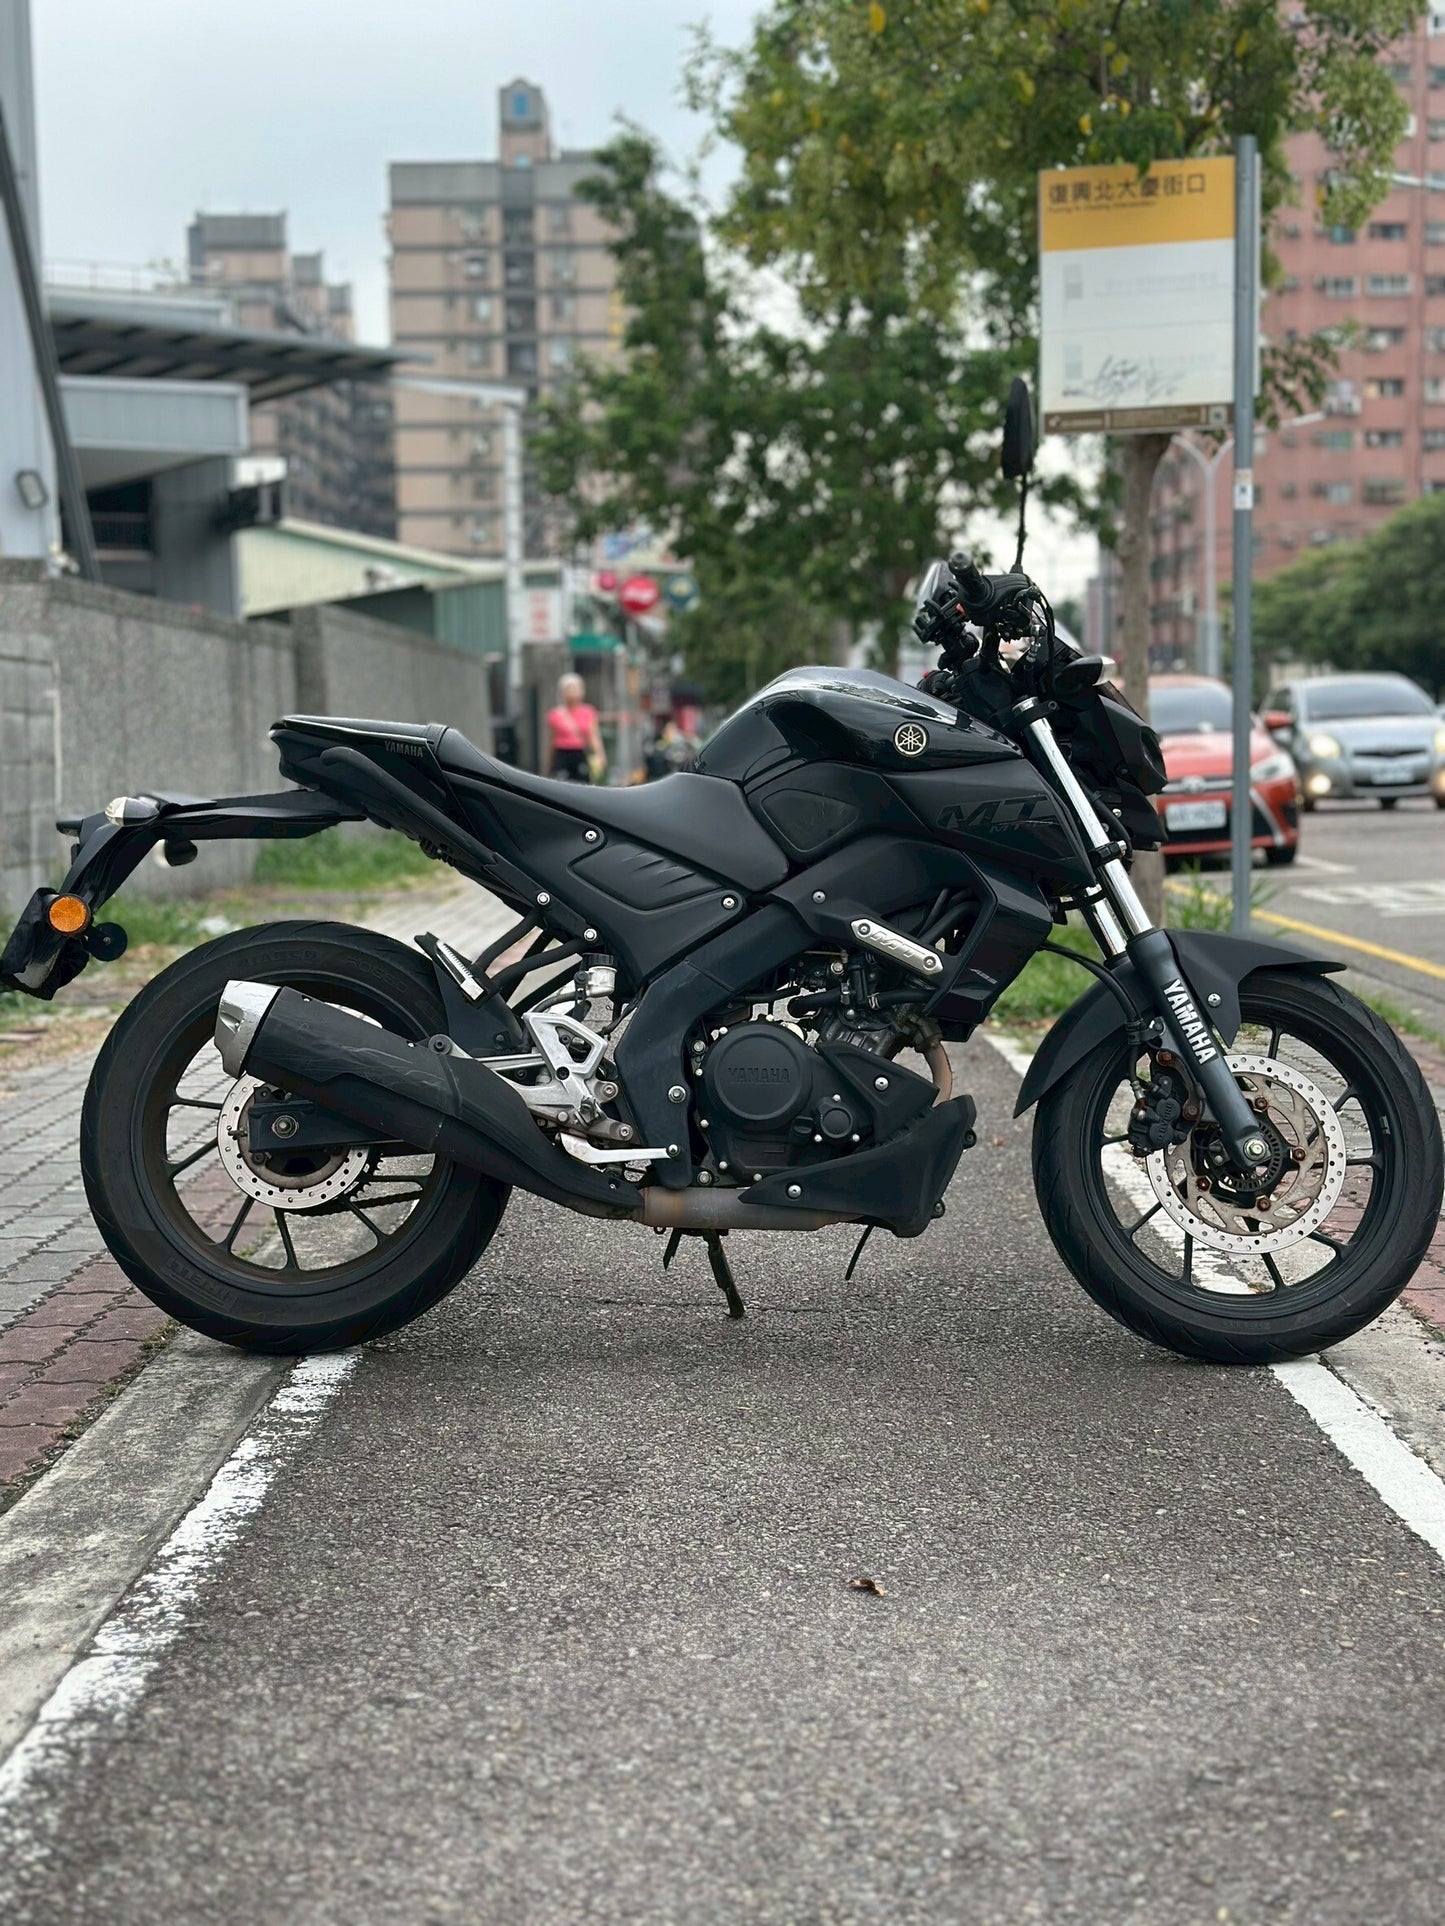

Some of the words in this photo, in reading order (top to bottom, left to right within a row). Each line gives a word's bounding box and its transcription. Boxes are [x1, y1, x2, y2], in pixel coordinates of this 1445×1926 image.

[384, 740, 424, 758] YAMAHA
[869, 930, 926, 959] MT
[1163, 978, 1217, 1065] YAMAHA
[727, 1066, 791, 1084] YAMAHA
